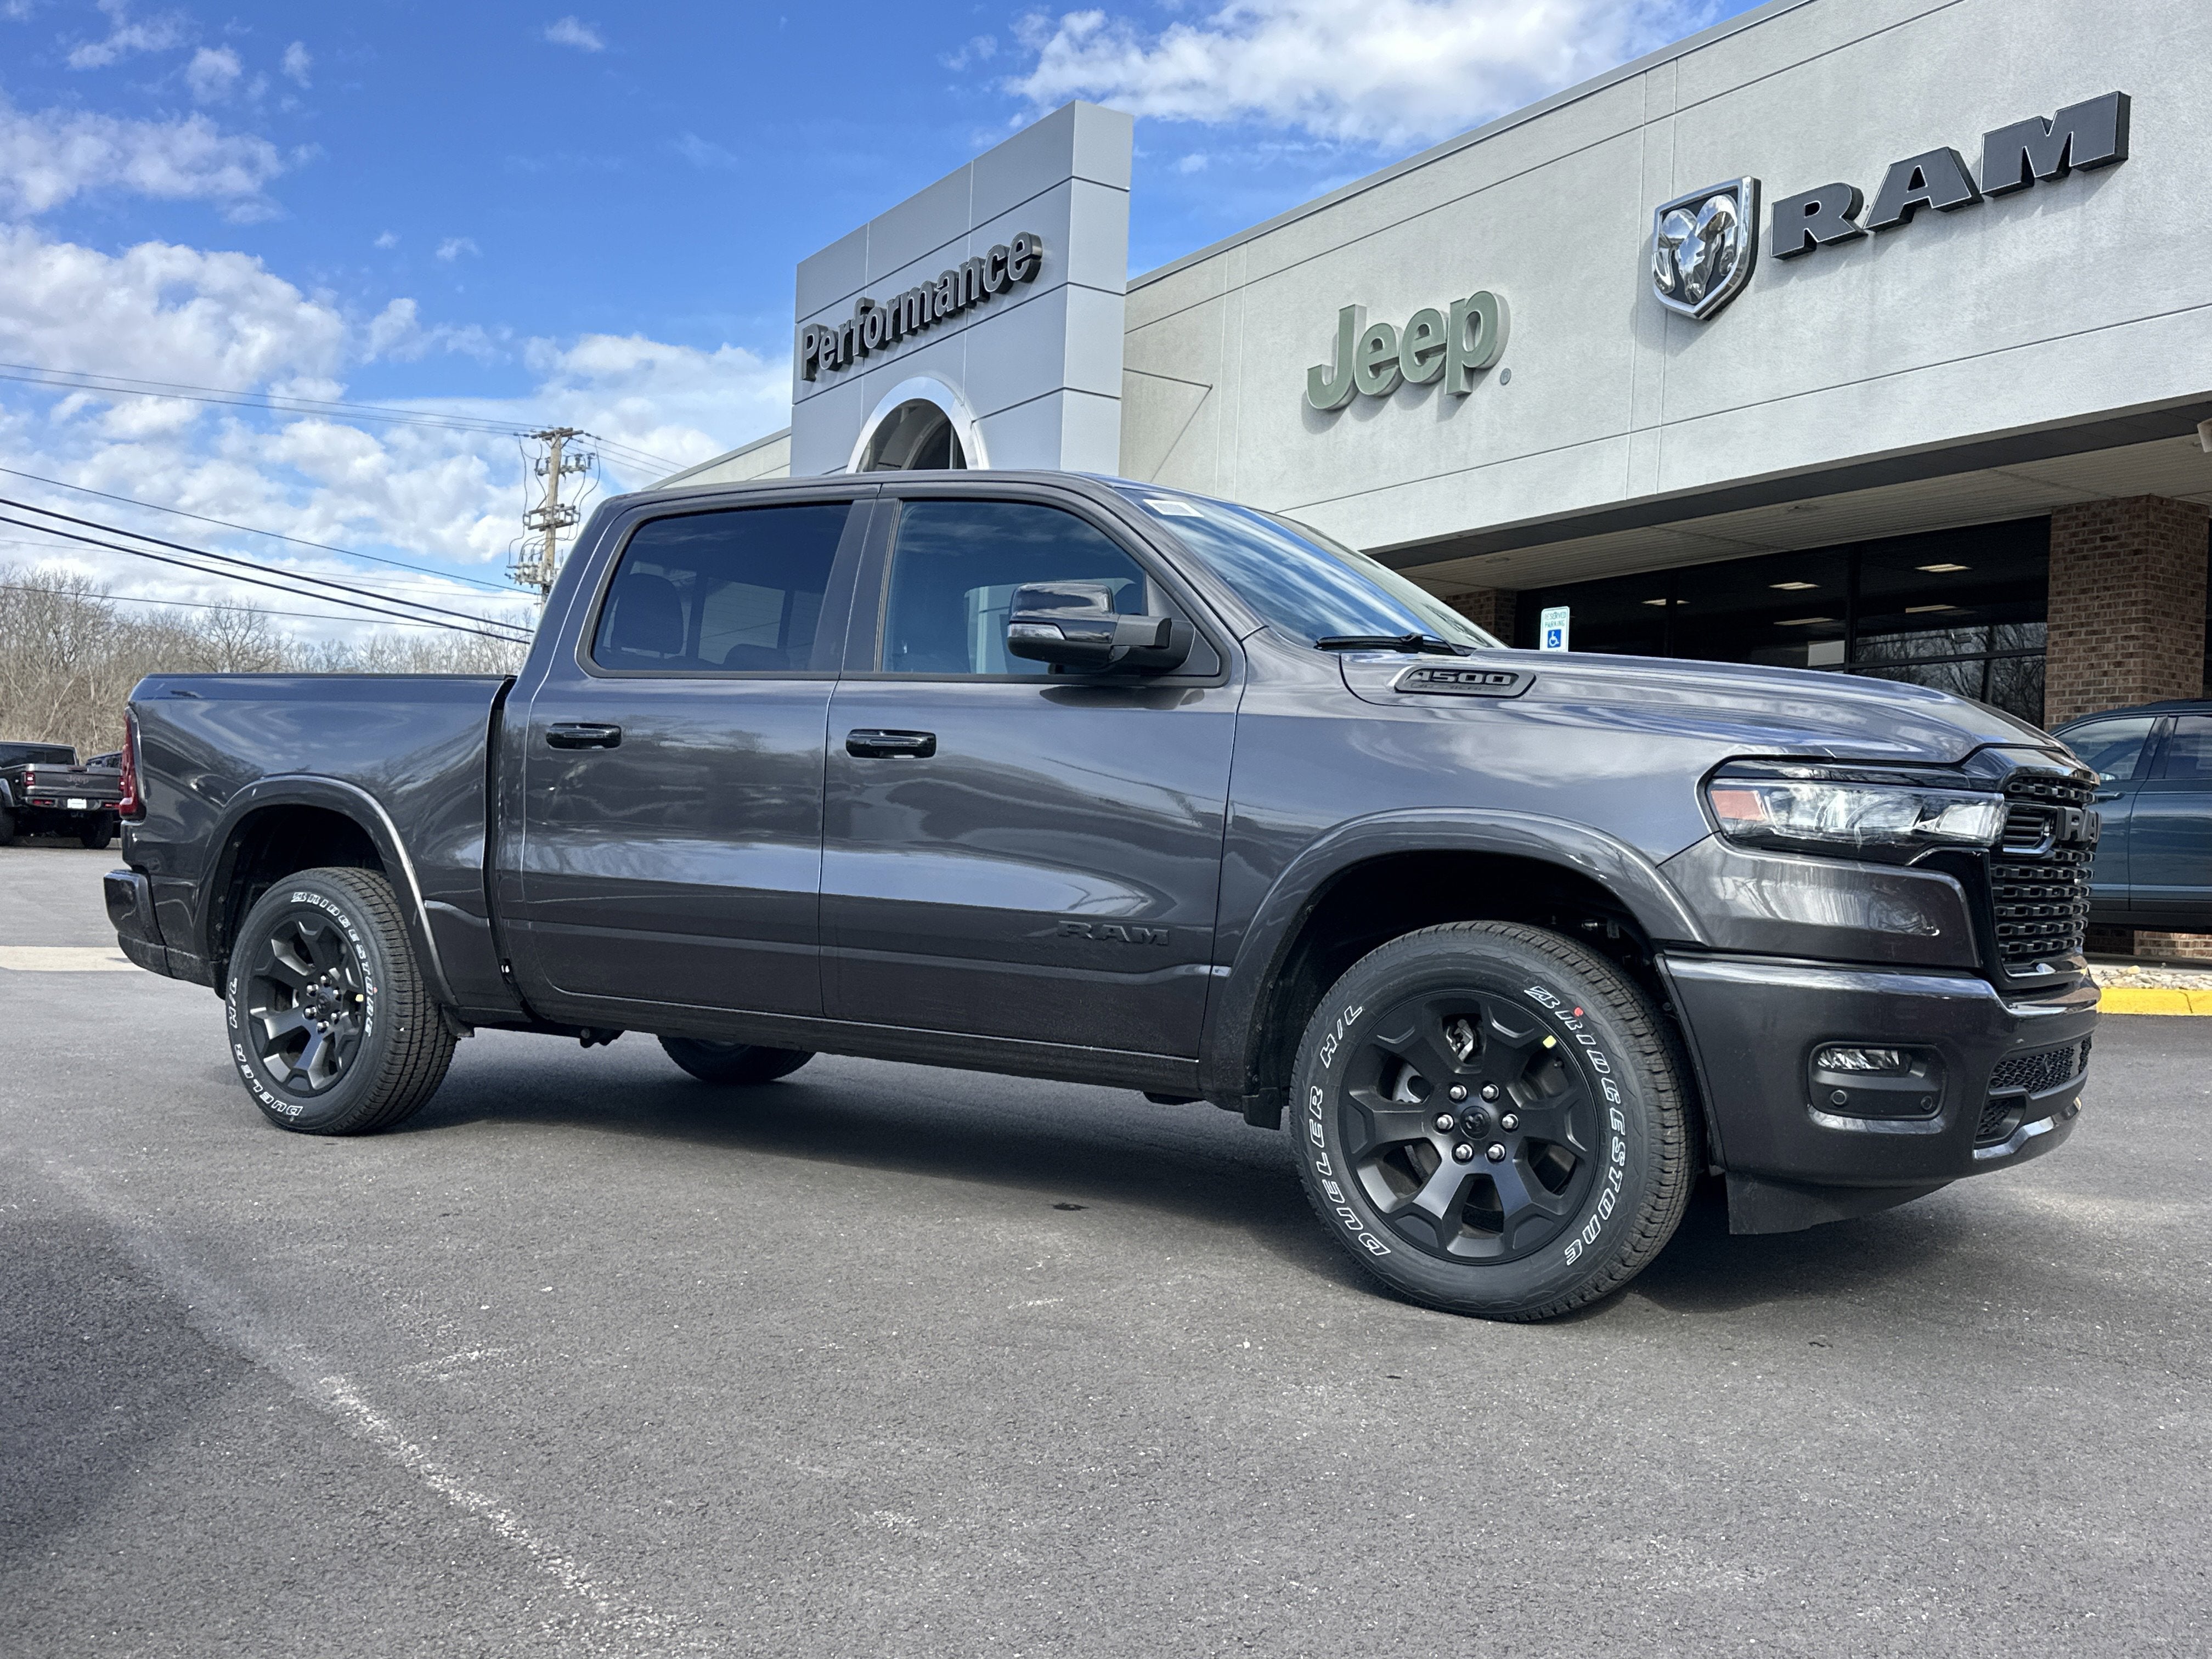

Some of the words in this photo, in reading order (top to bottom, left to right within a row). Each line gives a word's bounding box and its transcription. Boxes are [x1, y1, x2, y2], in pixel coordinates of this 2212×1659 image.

[1770, 91, 2131, 260] RAM
[800, 231, 1042, 381] Performance
[1307, 290, 1510, 410] Jeep
[1409, 670, 1511, 685] 1500
[66, 774, 89, 785] Jeep
[291, 891, 373, 1037] BRIDGESTONE
[1057, 920, 1169, 946] RAM
[234, 1043, 303, 1116] DUELER
[1523, 986, 1626, 1266] BRIDGESTONE
[1309, 1086, 1391, 1256] DUELER
